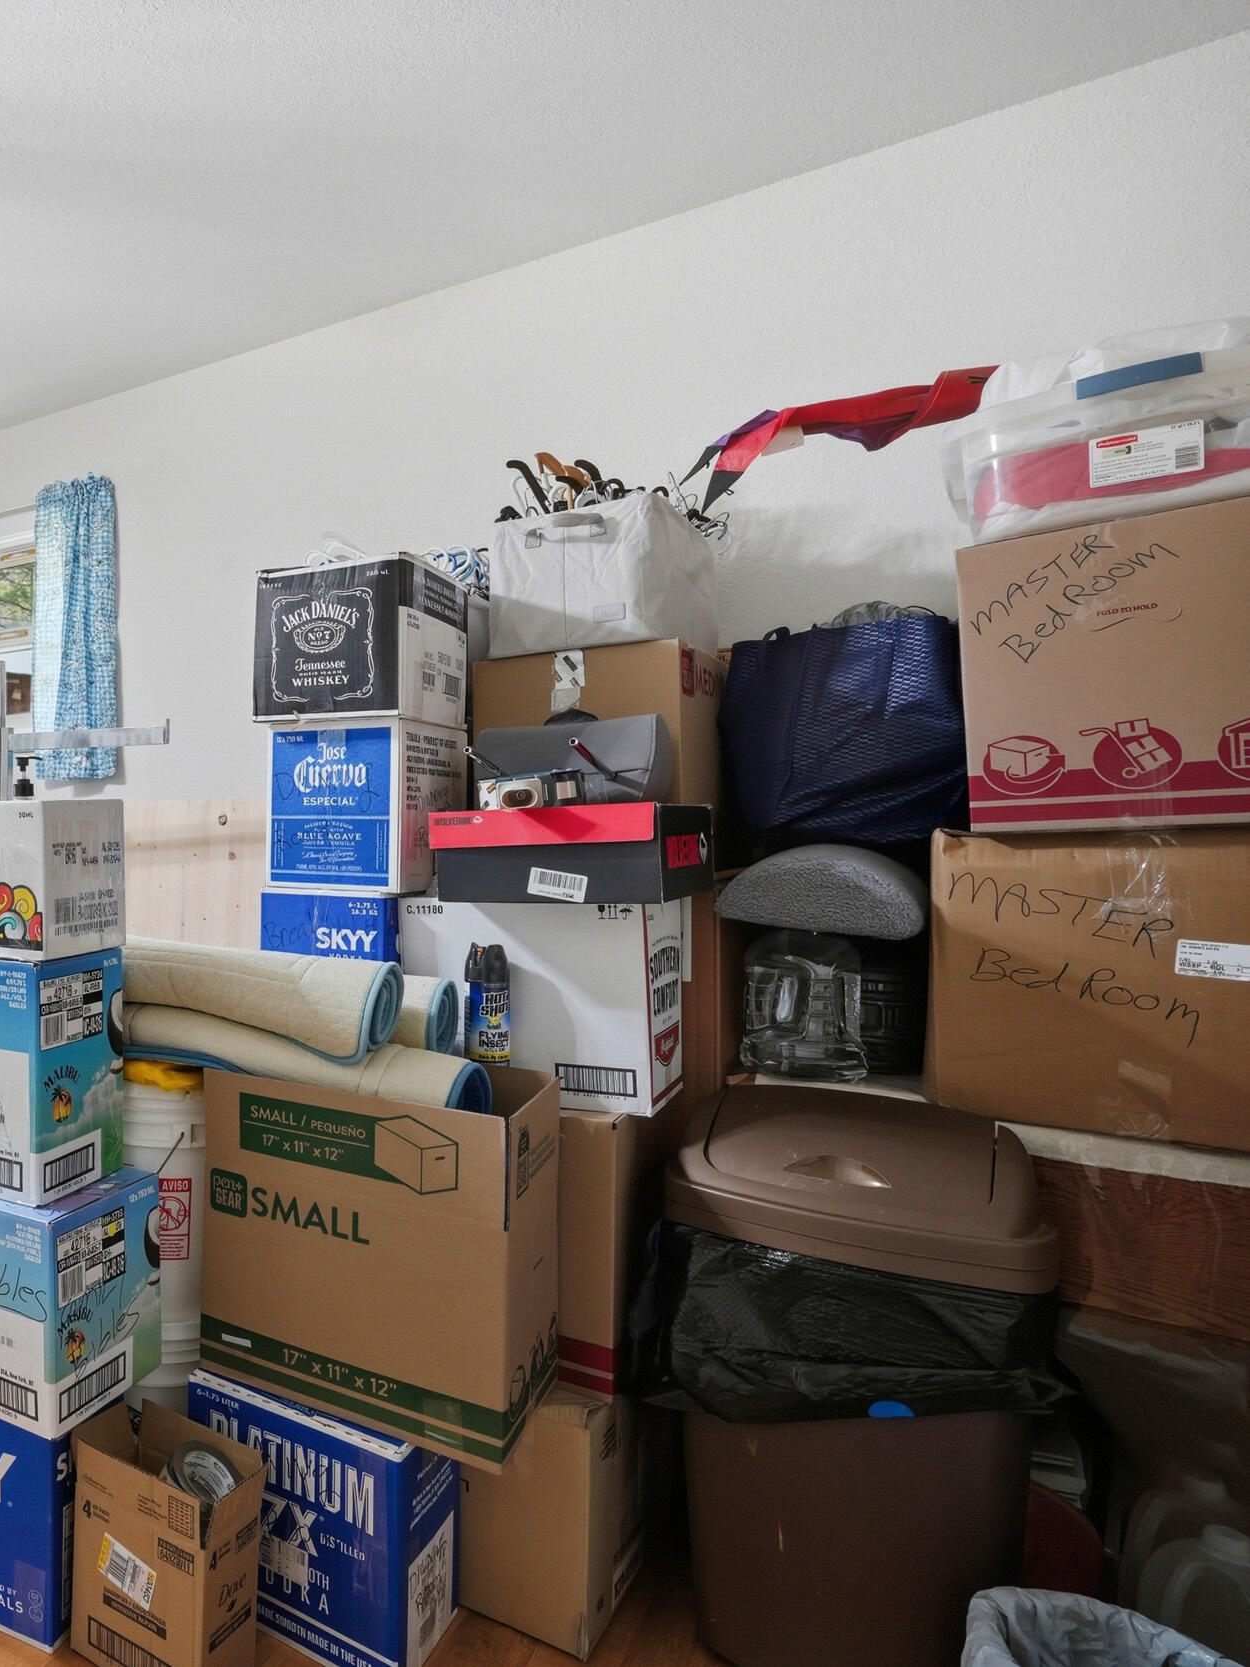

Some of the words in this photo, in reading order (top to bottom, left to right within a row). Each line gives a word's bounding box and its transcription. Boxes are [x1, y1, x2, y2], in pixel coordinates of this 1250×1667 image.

[970, 534, 1114, 636] MASTER
[281, 605, 312, 633] JACK
[310, 599, 360, 629] DANIEL'S
[1096, 608, 1119, 617] FOLD
[1121, 607, 1131, 615] TO
[1132, 602, 1158, 612] HOLD
[295, 657, 347, 672] Tennessee
[292, 674, 350, 687] WHISKEY
[317, 742, 347, 764] Jose
[293, 756, 367, 793] Cuervo
[303, 796, 356, 807] ESPECIAL
[297, 832, 324, 840] BLUE
[327, 832, 363, 841] AGAVE
[949, 872, 1175, 960] MASTER
[315, 927, 378, 953] SKYY
[650, 945, 680, 986] SOUTHERN
[970, 947, 1070, 992] Bed
[483, 990, 509, 1006] HOT
[653, 978, 679, 1018] COMFORT
[480, 1003, 509, 1018] SHOT
[478, 1040, 509, 1049] INSECT
[479, 1031, 510, 1041] FLYING
[43, 1064, 81, 1093] MALIBU
[250, 1104, 297, 1127] SMALL
[310, 1119, 367, 1140] PEQUEÑO
[261, 1133, 280, 1148] 17"
[324, 1147, 345, 1162] 12"
[161, 1180, 189, 1191] AVISO
[214, 1188, 244, 1211] GEAR
[251, 1186, 370, 1247] SMALL
[282, 1347, 307, 1366] 17"
[312, 1361, 322, 1375] x
[326, 1363, 349, 1381] 11"
[353, 1376, 364, 1389] x
[369, 1376, 397, 1398] 12"
[196, 1388, 220, 1404] 6-1.75
[82, 1499, 92, 1520] 4
[217, 1573, 247, 1608] Dove
[308, 1567, 330, 1591] OTH
[6, 1587, 18, 1597] BY
[275, 1613, 307, 1639] SMOOTH
[307, 1630, 329, 1652] MADE
[330, 1643, 339, 1657] IN
[340, 1647, 356, 1665] THE
